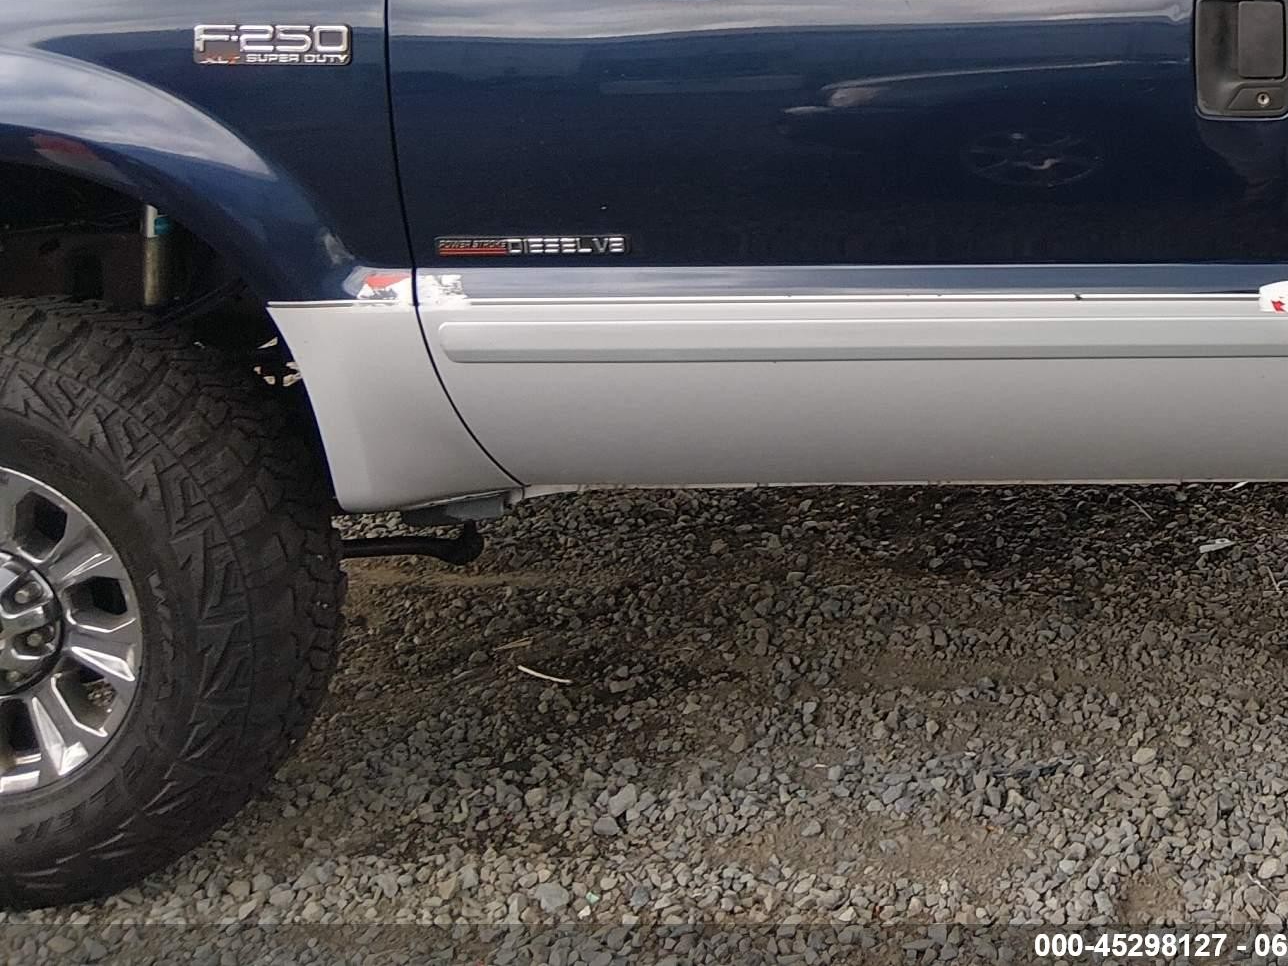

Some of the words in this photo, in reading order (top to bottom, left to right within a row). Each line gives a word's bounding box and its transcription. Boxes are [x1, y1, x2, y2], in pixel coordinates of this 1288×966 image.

[246, 54, 299, 63] SUPER
[304, 54, 348, 63] DUTY
[440, 240, 471, 248] POWER
[473, 239, 506, 248] STROKE
[507, 238, 592, 253] DIESEL
